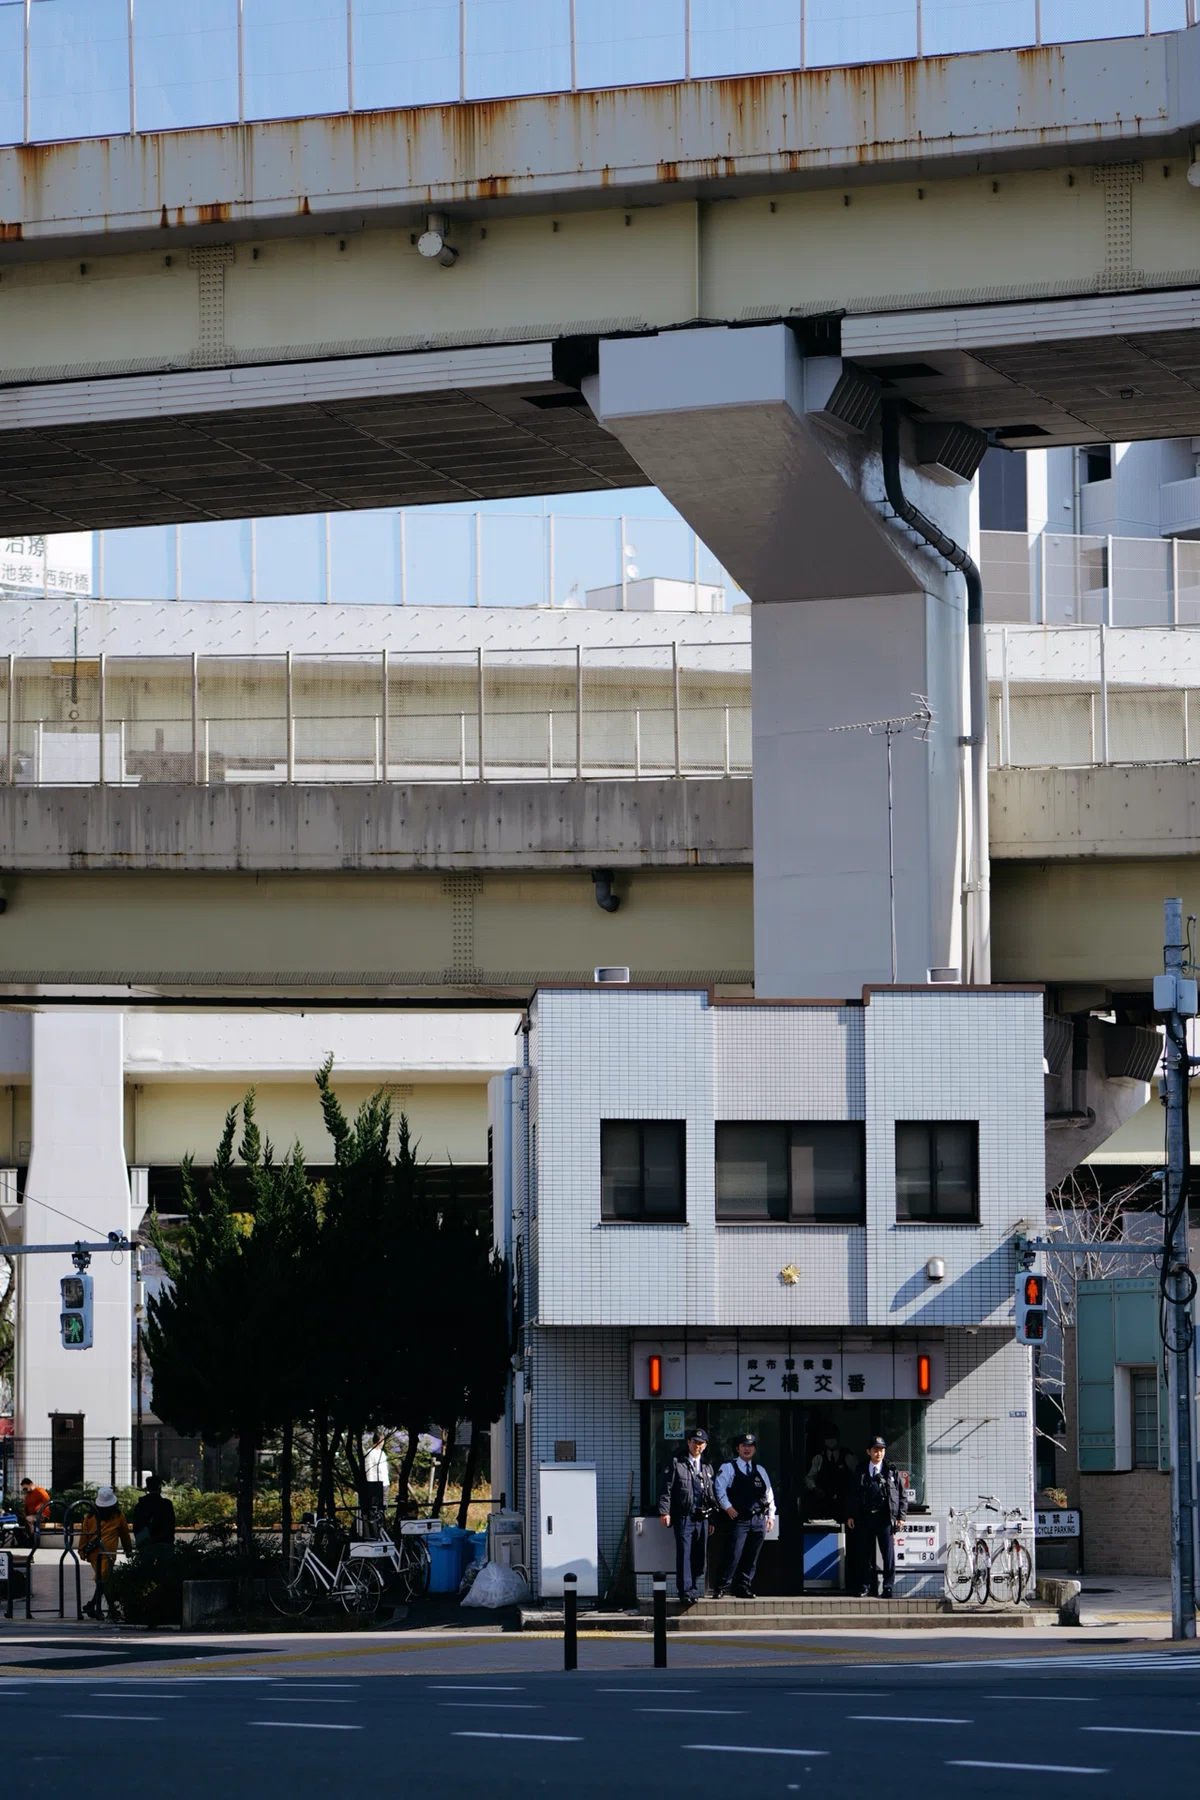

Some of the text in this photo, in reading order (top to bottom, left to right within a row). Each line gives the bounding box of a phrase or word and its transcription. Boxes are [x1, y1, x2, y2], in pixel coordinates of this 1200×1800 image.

[747, 1359, 833, 1371] 麻布警察署
[714, 1374, 866, 1393] 一之橋交番
[1054, 1525, 1075, 1535] PARKING
[928, 1537, 934, 1547] 0
[921, 1552, 935, 1561] 80
